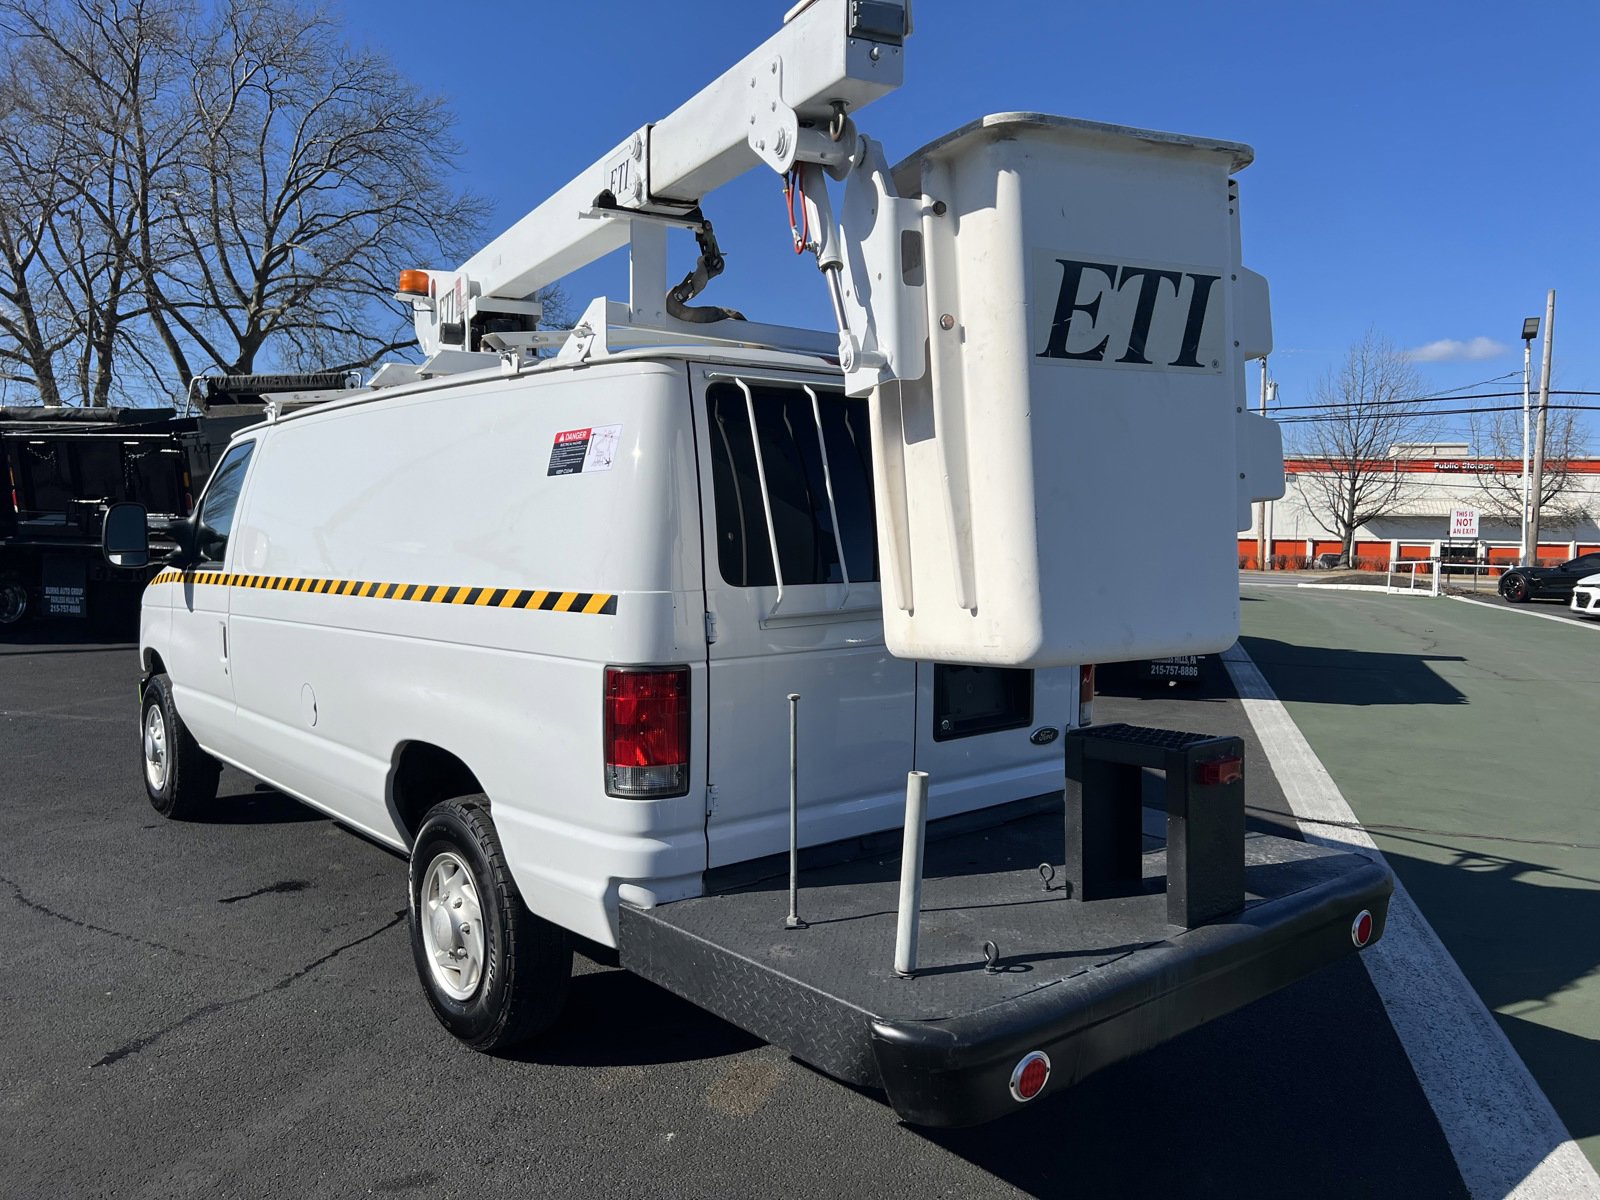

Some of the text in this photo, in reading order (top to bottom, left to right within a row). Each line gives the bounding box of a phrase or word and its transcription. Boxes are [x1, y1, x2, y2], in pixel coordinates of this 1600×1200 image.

[610, 159, 630, 195] ETI
[1036, 259, 1221, 367] ETI
[565, 431, 587, 441] DANGER
[1462, 462, 1495, 470] Storage
[1456, 518, 1473, 526] NOT
